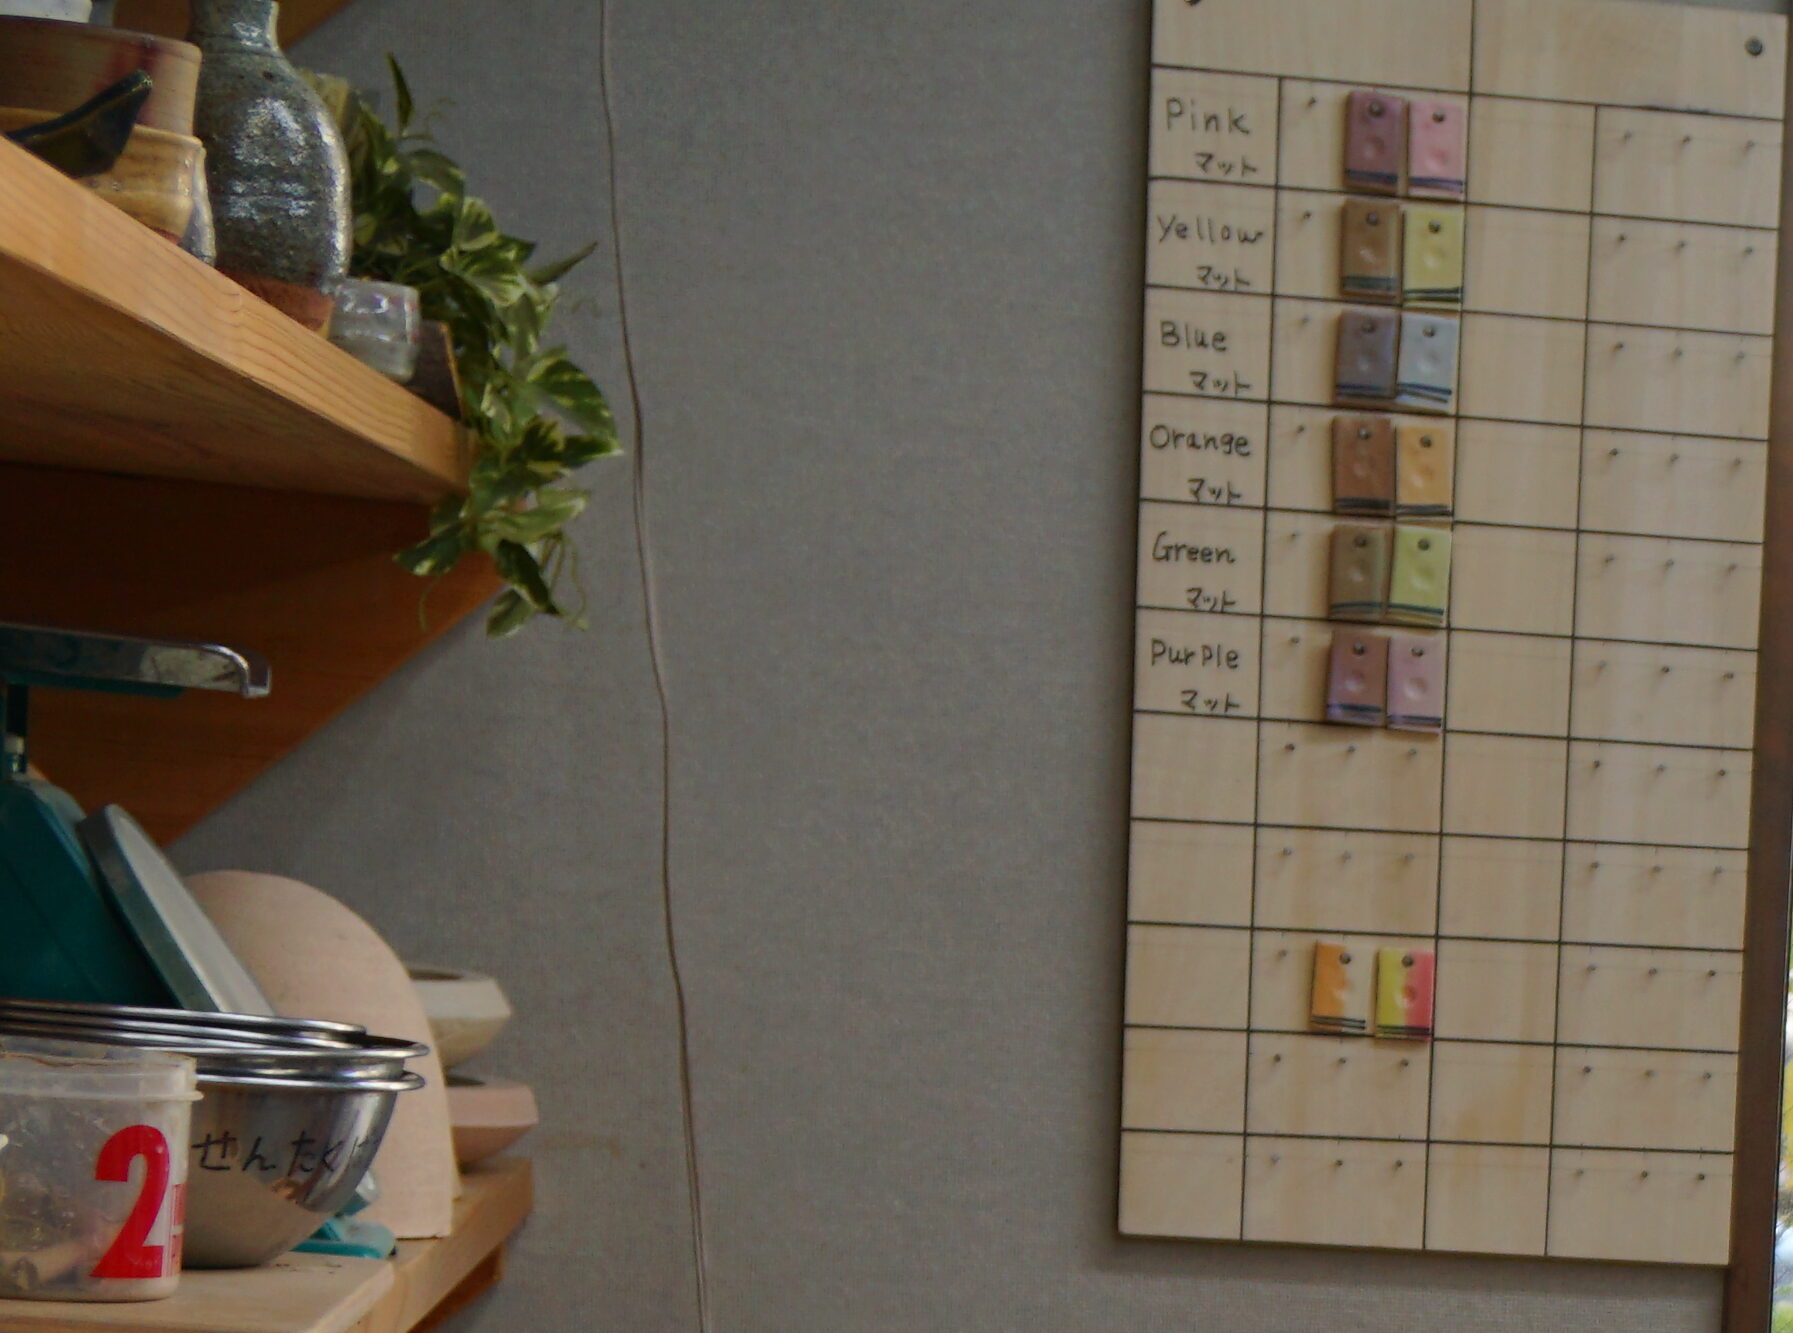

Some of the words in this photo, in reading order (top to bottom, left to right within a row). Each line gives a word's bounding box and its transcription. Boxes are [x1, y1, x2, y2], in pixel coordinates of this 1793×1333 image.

[1165, 97, 1251, 136] Pink
[1160, 319, 1228, 353] Blue
[1149, 423, 1252, 458] Orange
[1152, 530, 1236, 566] Green
[88, 1124, 170, 1278] 2
